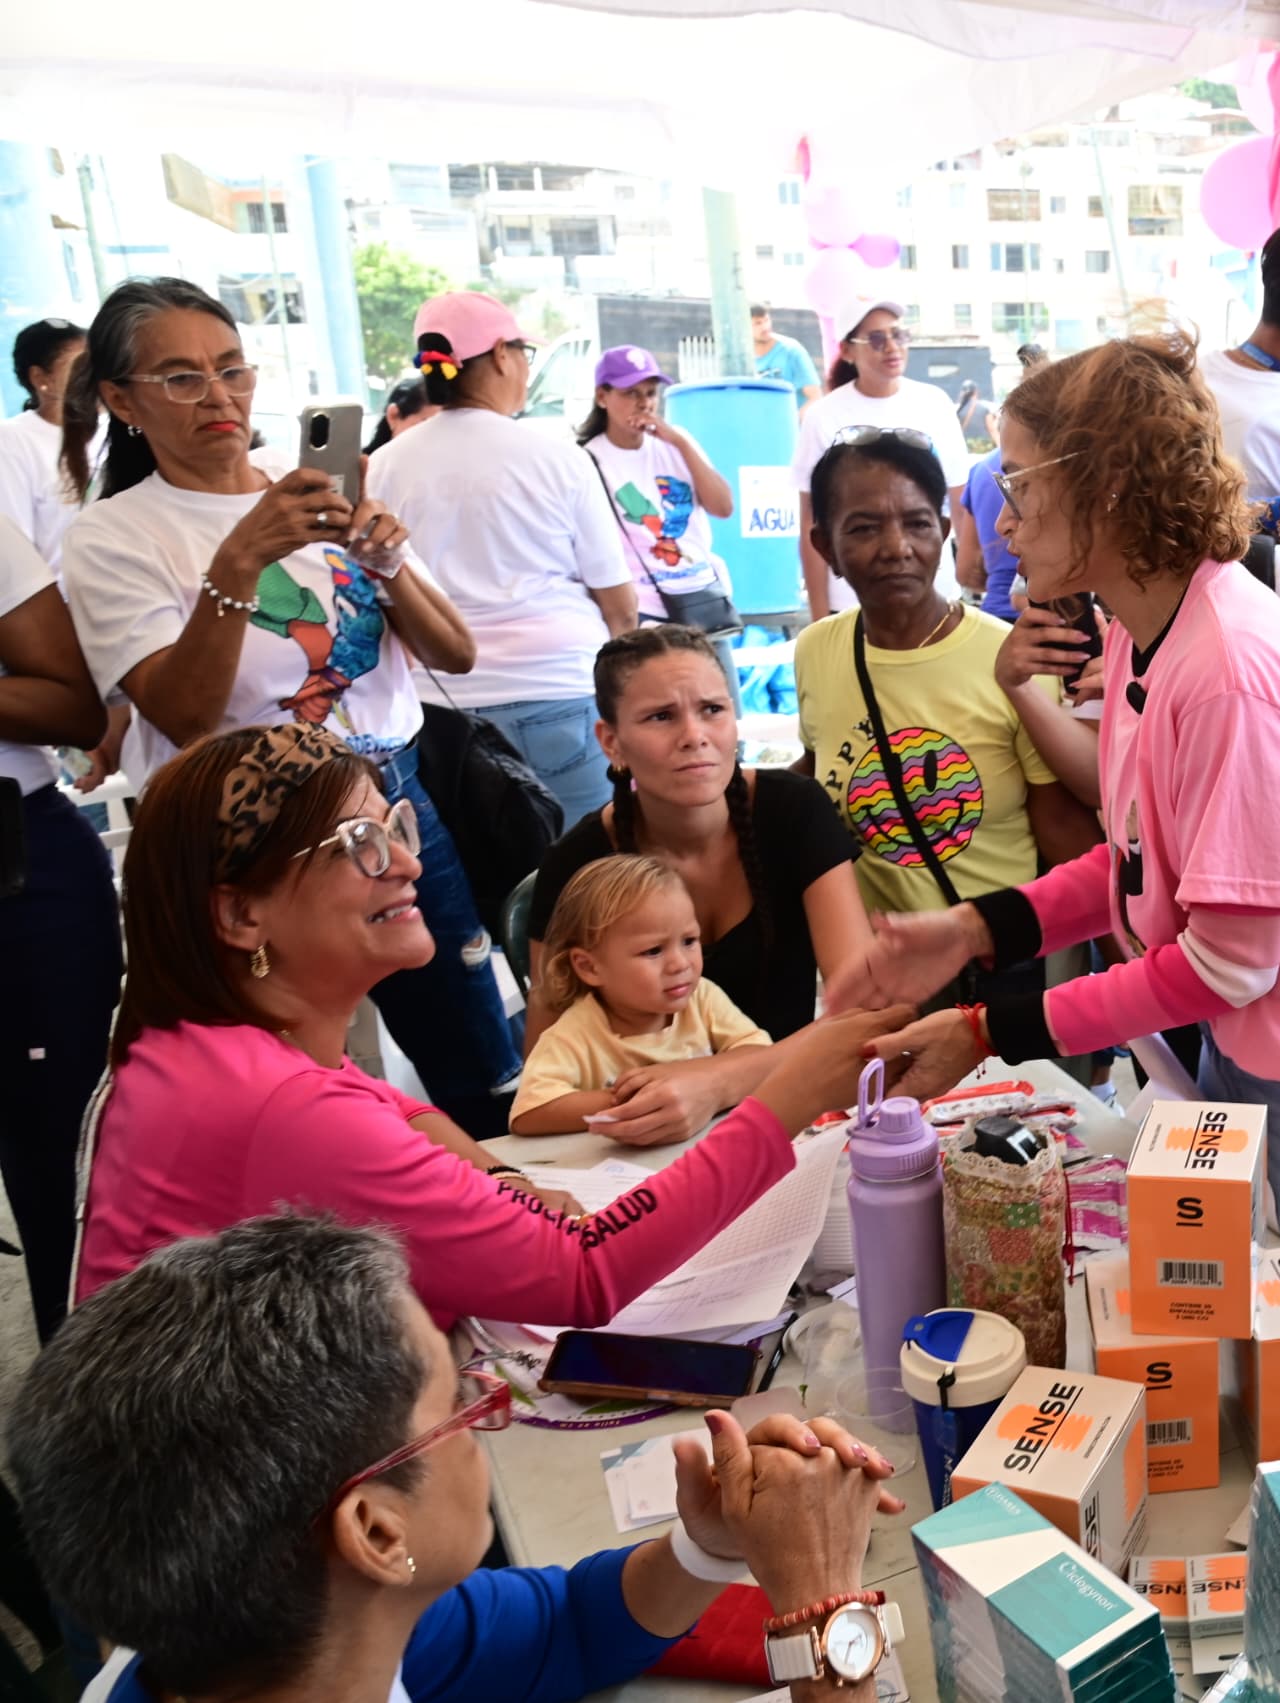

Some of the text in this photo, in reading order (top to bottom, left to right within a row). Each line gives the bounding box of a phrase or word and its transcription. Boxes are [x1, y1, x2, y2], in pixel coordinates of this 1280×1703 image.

[1191, 1111, 1228, 1170] SENSE
[1176, 1197, 1204, 1220] S
[1146, 1362, 1173, 1383] S
[1004, 1383, 1077, 1471] SENSE
[1058, 1561, 1114, 1612] Ciclogynon
